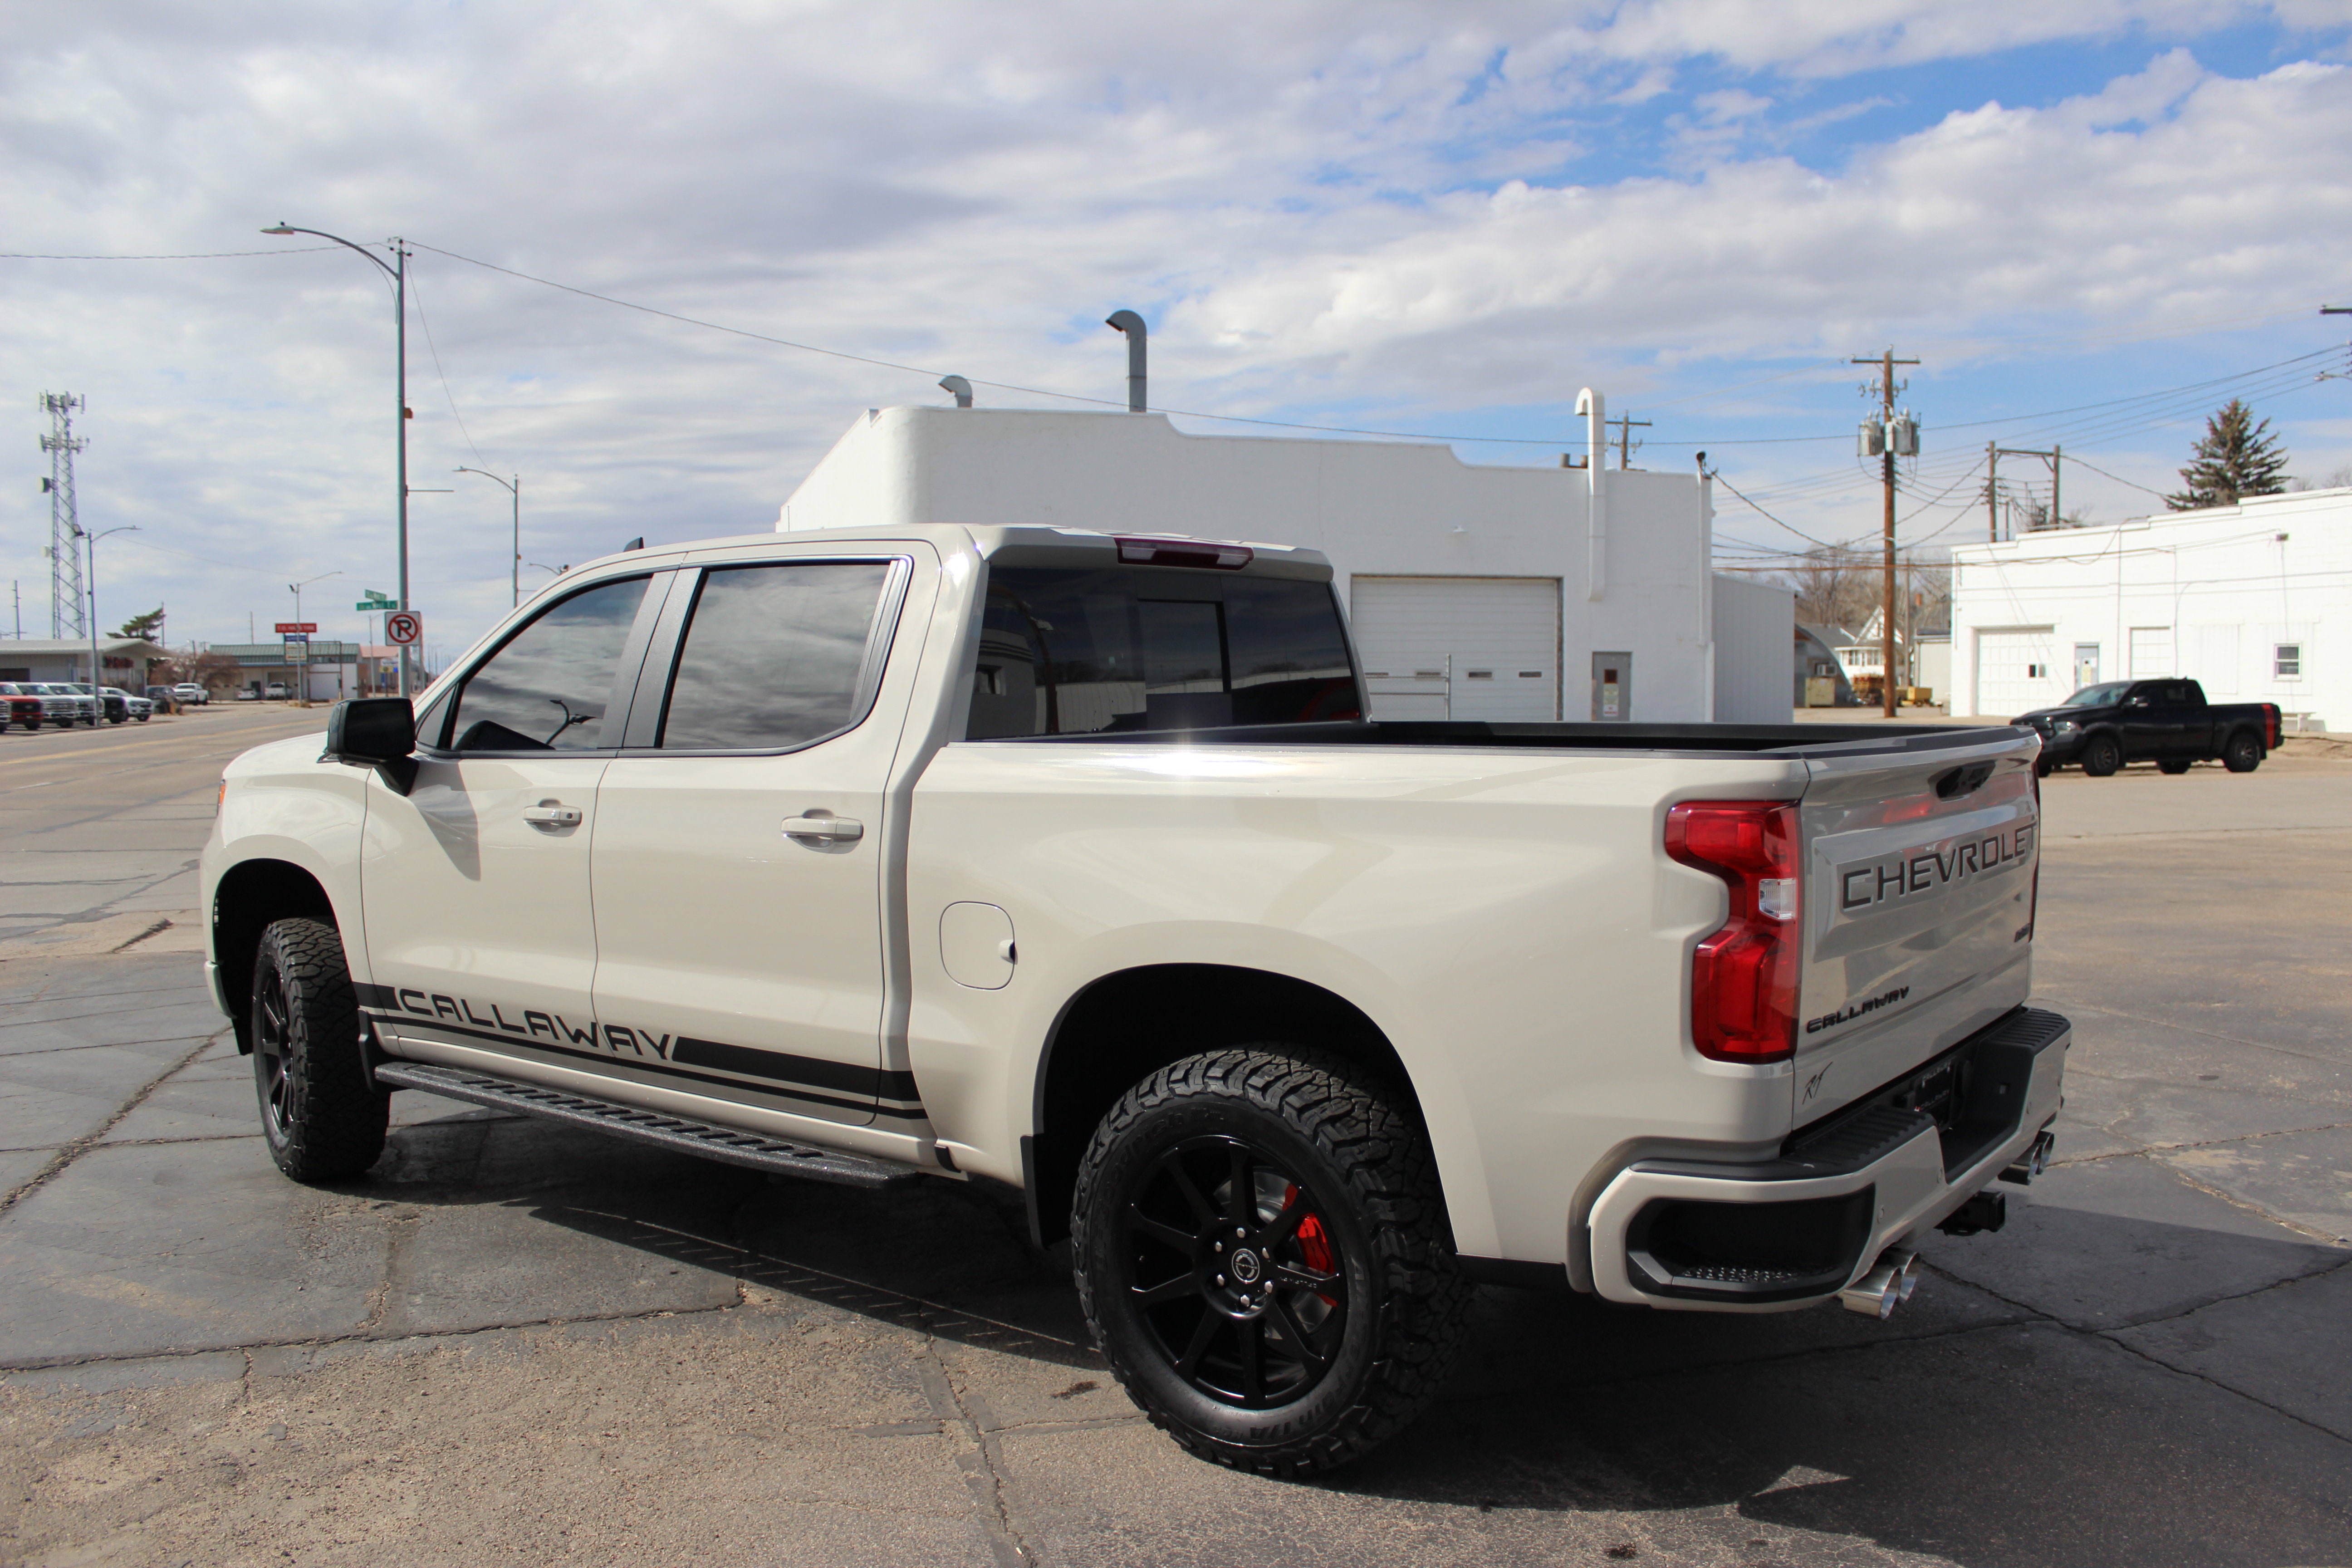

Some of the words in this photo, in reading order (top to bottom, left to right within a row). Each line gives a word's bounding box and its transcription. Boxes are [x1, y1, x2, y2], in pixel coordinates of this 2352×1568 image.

[1843, 820, 2037, 909] CHEVROLET
[400, 989, 670, 1060] CALLAWAY
[1806, 986, 1909, 1034] CALLAWAY
